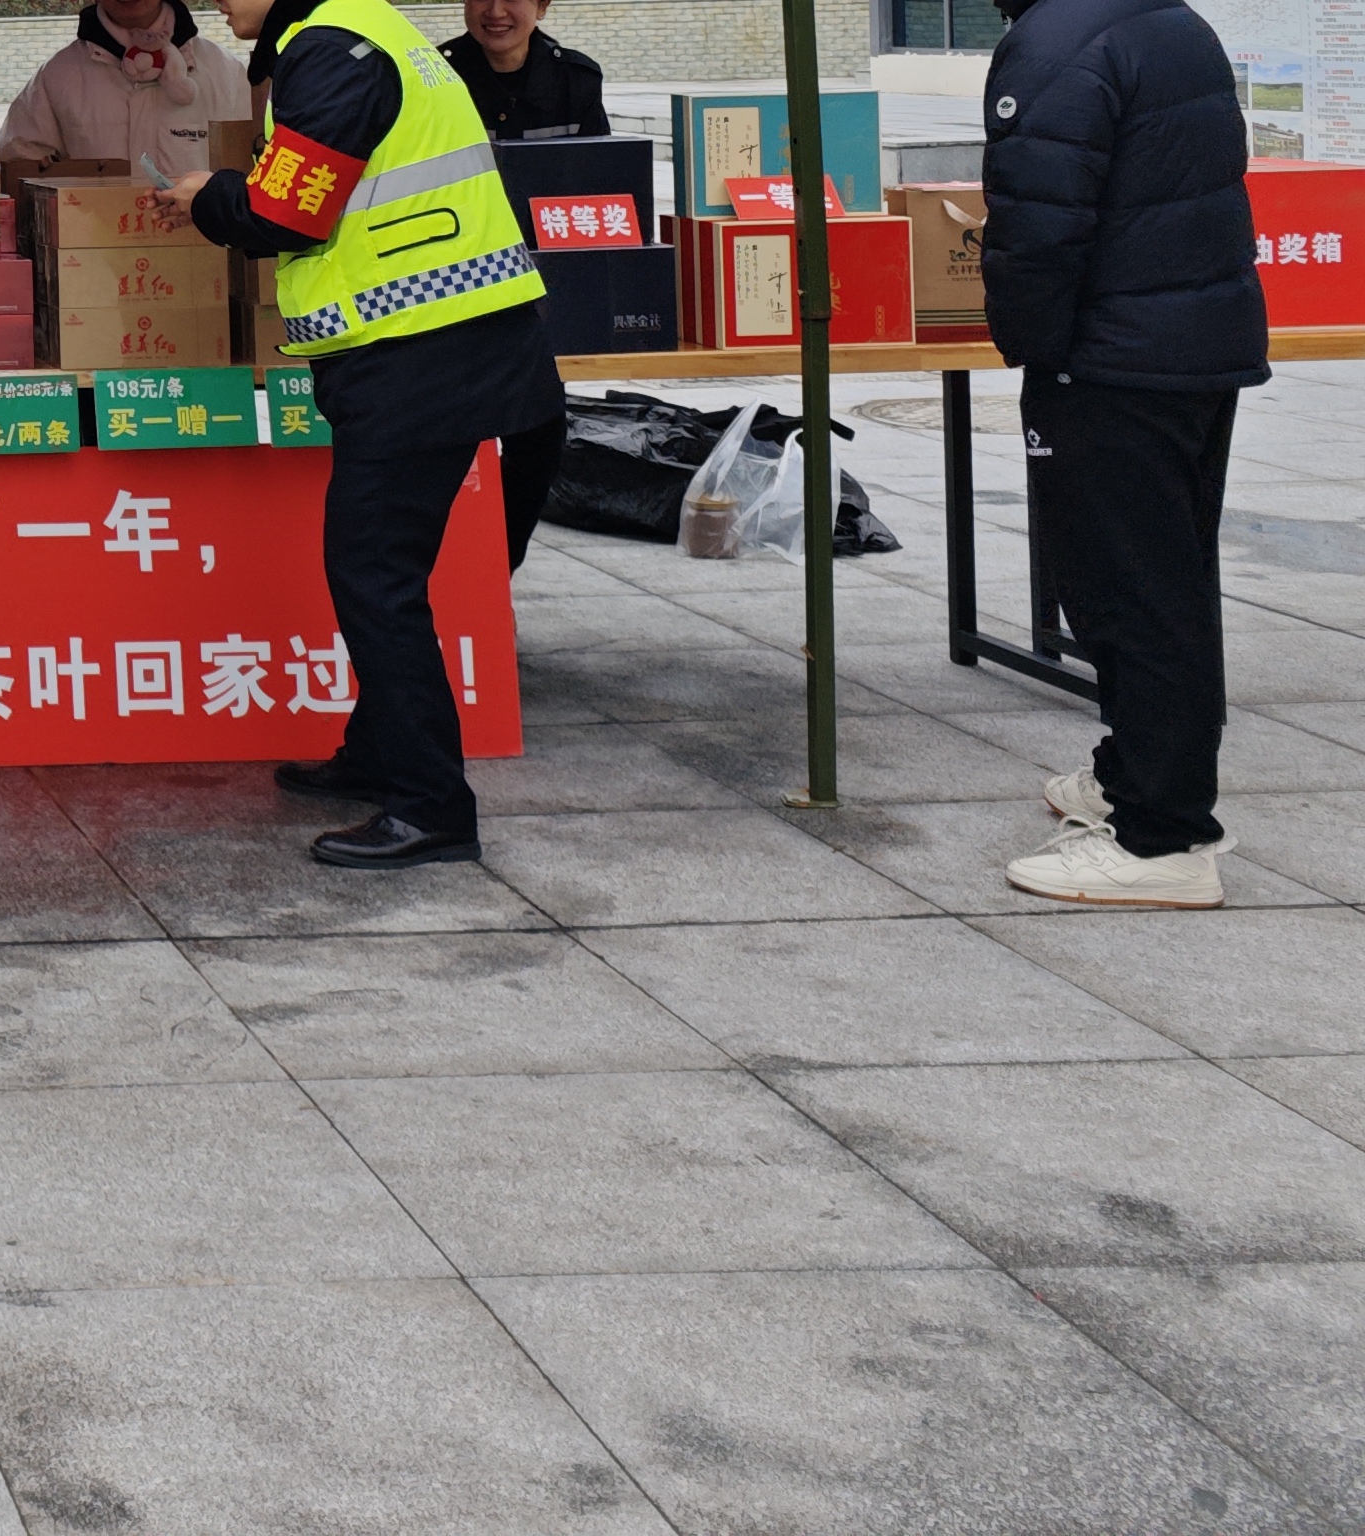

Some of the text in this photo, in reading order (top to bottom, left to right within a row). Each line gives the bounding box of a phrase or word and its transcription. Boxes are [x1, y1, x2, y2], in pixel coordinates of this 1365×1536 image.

[738, 182, 834, 210] 一等
[539, 203, 632, 239] 特等奖
[106, 376, 185, 400] 198元/条
[278, 377, 313, 396] 198
[107, 404, 243, 438] 买一赠一
